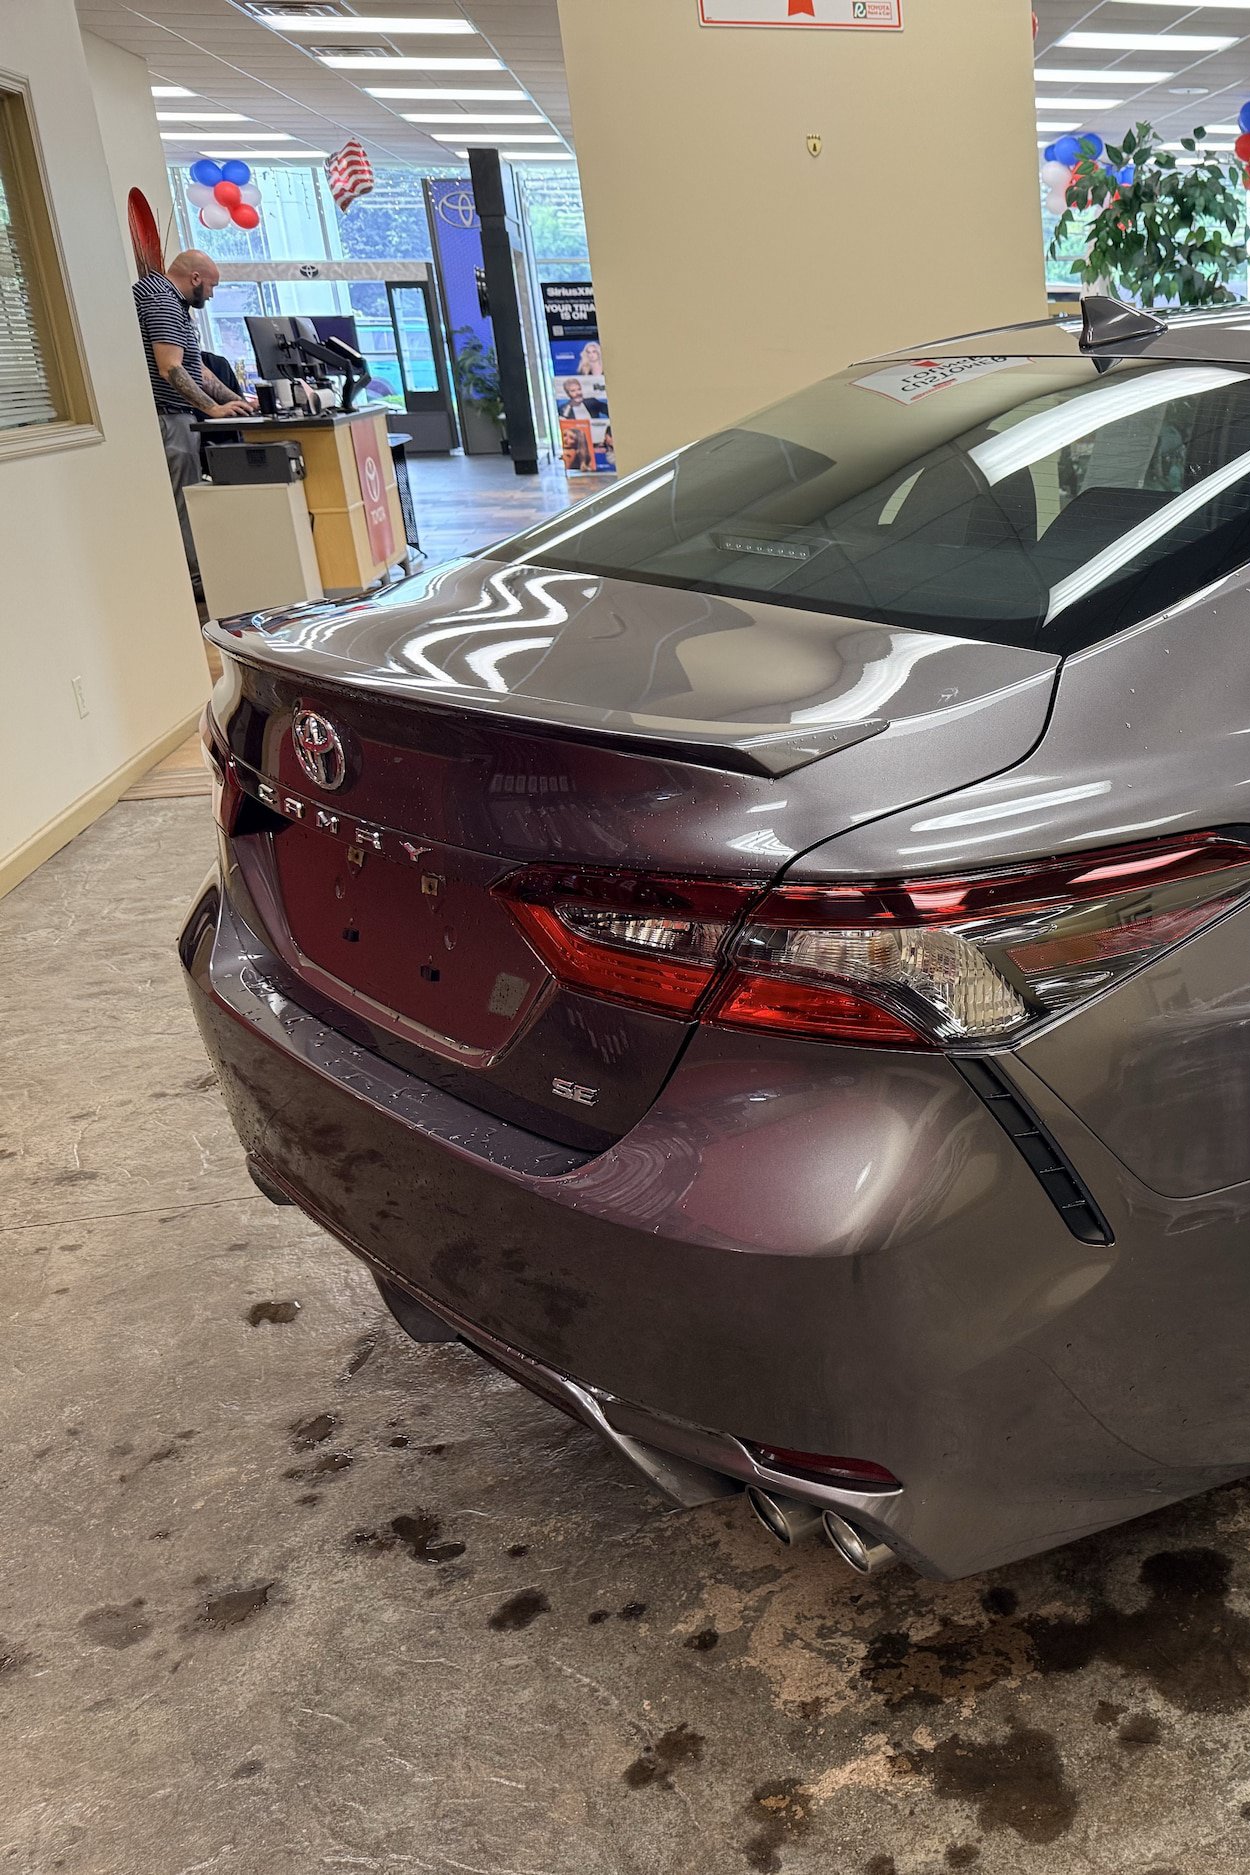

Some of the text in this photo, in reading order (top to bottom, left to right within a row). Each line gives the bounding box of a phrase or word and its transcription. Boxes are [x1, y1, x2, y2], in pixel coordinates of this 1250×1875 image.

[546, 287, 594, 297] SiriusXM
[545, 303, 596, 313] YOUR TRIA
[560, 311, 588, 320] IS ON
[258, 783, 434, 862] CAMRY
[551, 1077, 601, 1107] SE
